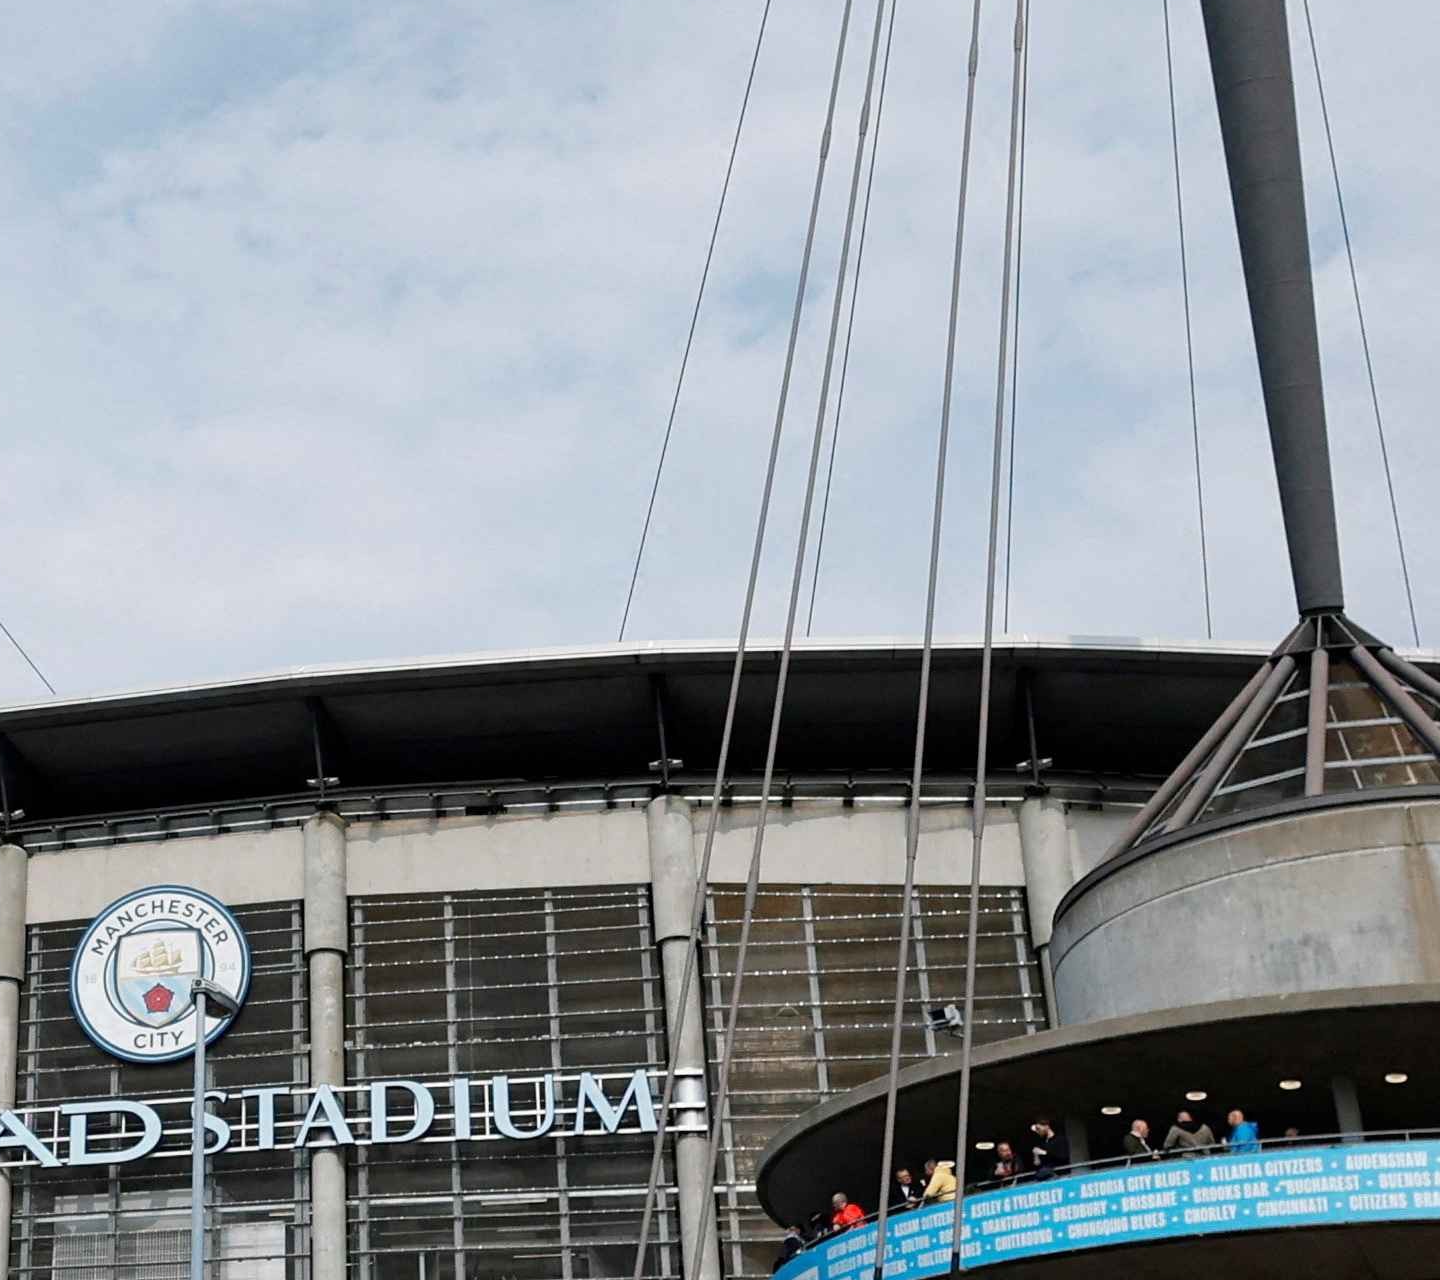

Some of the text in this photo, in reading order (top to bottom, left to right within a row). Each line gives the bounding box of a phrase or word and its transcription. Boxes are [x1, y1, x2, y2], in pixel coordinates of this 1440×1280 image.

[91, 899, 228, 956] MANCHESTER
[134, 1031, 184, 1049] CITY
[191, 1069, 658, 1156] STADIUM
[1128, 1176, 1151, 1193] CITY
[1210, 1162, 1262, 1181] ATLANTA
[1346, 1151, 1428, 1170] AUDENSHAW
